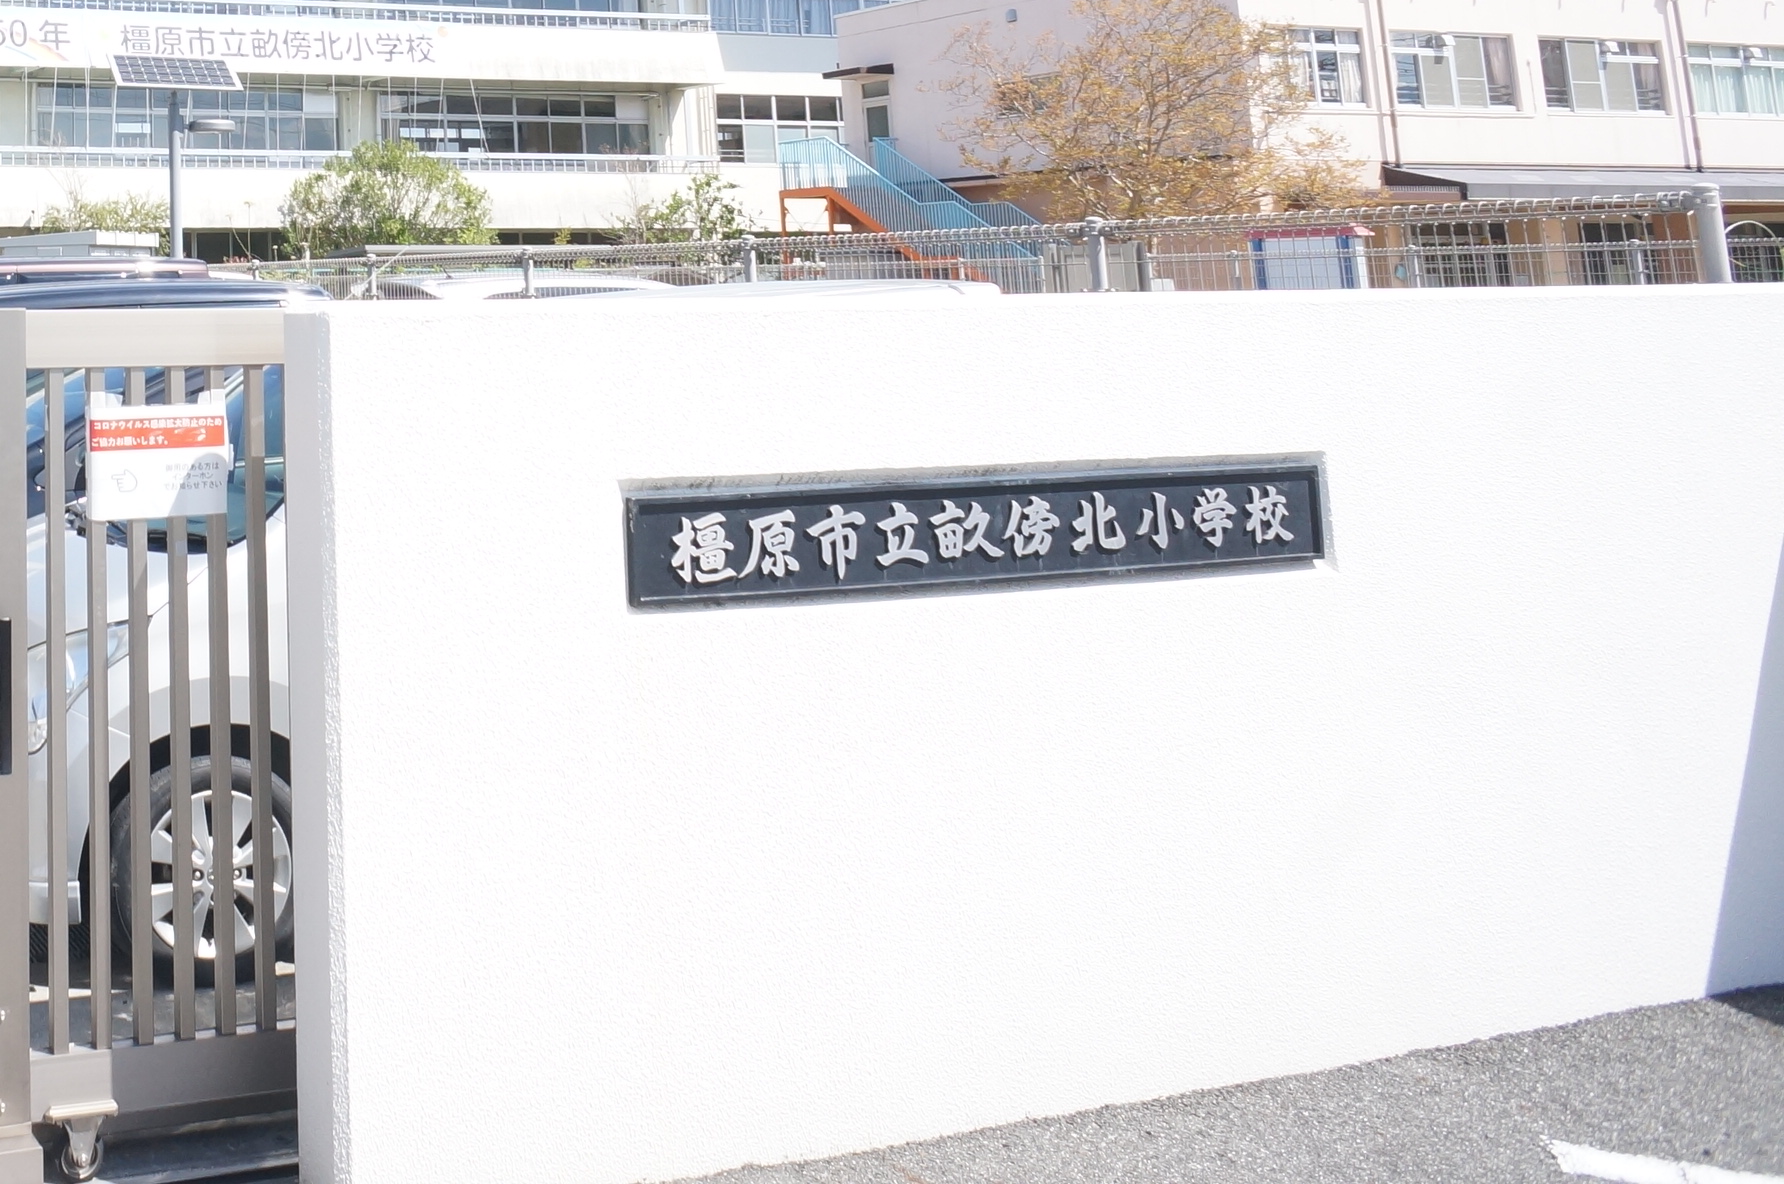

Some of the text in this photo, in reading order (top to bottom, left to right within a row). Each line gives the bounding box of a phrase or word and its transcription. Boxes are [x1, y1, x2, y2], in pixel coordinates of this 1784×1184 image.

[119, 24, 436, 64] 橿原市立畝傍北小学校
[93, 417, 223, 430] コロナウイルス感染拡大防止のため
[91, 436, 169, 448] ご協力お願いします。
[670, 483, 1296, 584] 橿原市立畝傍北小学校
